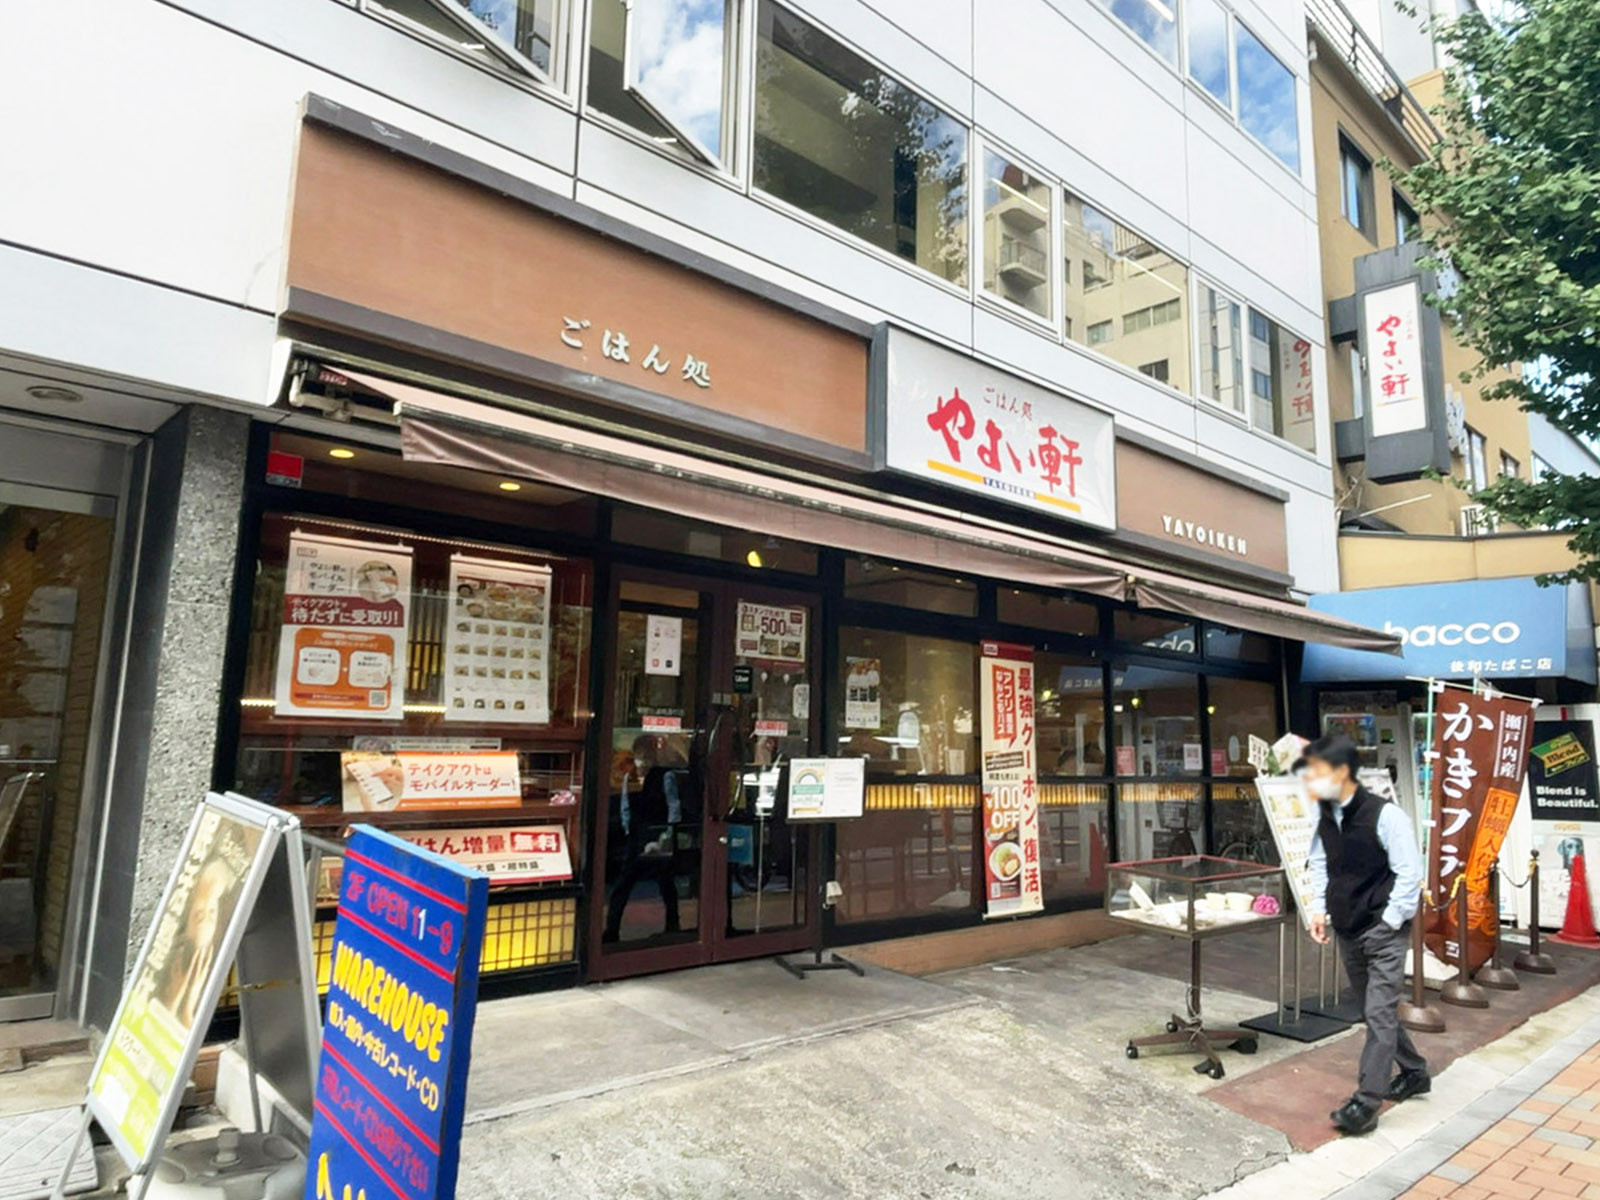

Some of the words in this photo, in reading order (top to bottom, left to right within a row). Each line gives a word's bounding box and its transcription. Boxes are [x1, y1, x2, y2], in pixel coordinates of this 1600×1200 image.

[561, 316, 711, 387] ごはん処
[1377, 315, 1410, 396] やよい軒
[983, 387, 1033, 421] ごはん処
[927, 386, 1083, 497] やよい軒
[1162, 514, 1246, 555] YAYOIKEN
[308, 582, 345, 592] オーダー
[761, 616, 786, 636] 500
[1500, 713, 1523, 780] 瀬戸内産
[408, 763, 492, 776] テイクアウトは
[409, 778, 516, 792] モバイルオーダー!
[1441, 702, 1494, 892] かきフラ
[1536, 786, 1572, 795] Blend
[1575, 787, 1586, 796] is
[1537, 797, 1599, 808] Beautiful.
[991, 810, 1021, 828] OFF
[514, 833, 557, 851] 無料
[367, 882, 409, 930] OPEN
[332, 940, 449, 1062] WAREHOUSE
